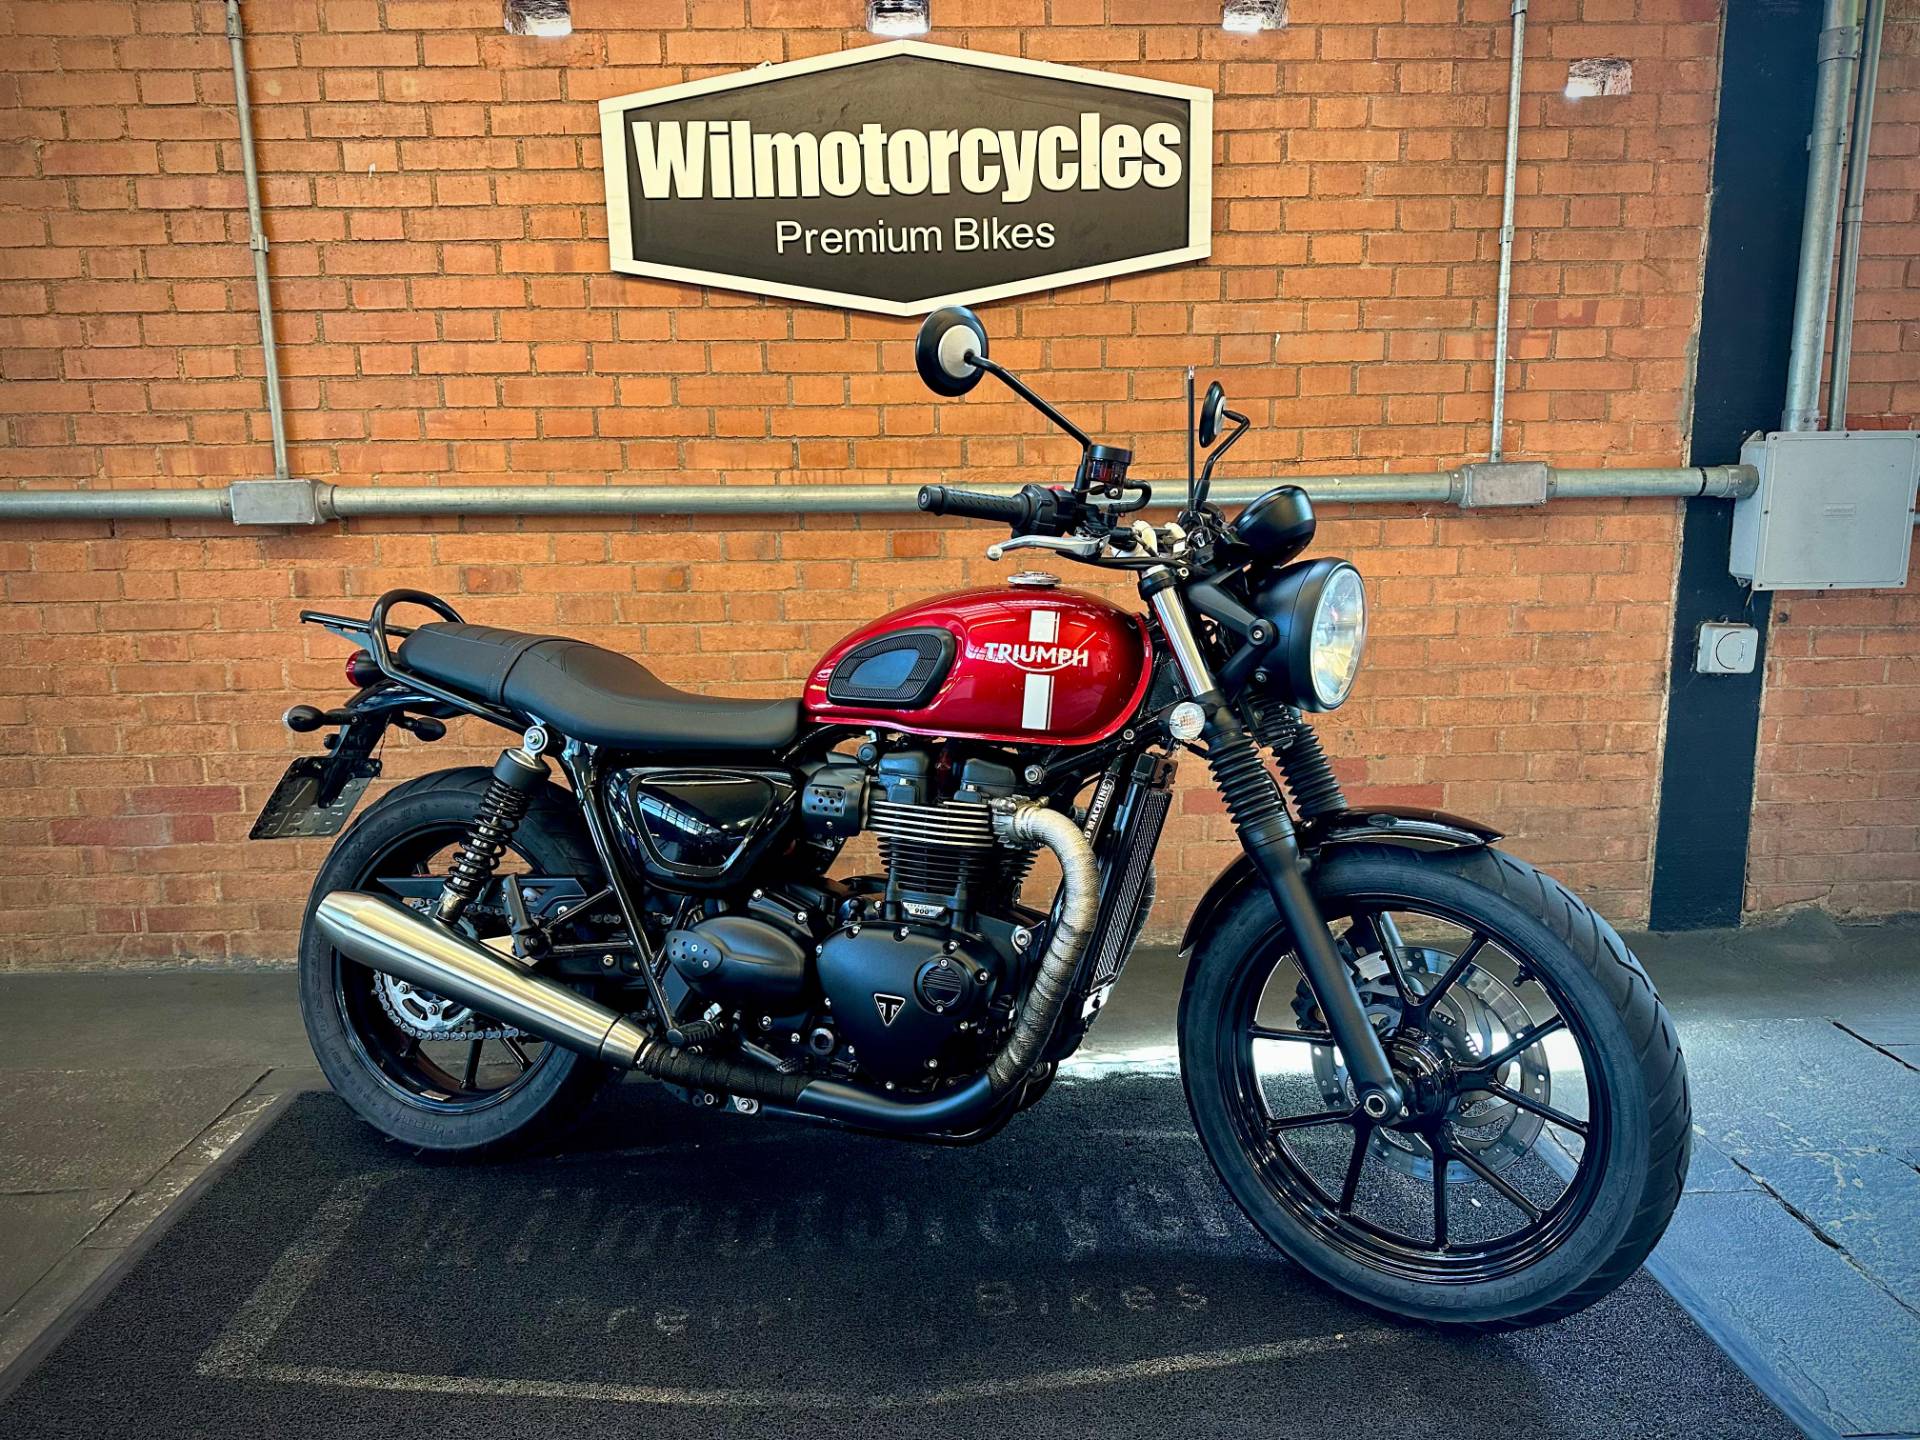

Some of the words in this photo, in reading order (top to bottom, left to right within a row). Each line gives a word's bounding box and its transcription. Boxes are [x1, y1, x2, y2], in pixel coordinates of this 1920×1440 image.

[632, 112, 1184, 203] Wilmotorcycles
[775, 219, 943, 254] Premium
[984, 641, 1090, 668] TRIUMPH
[1086, 781, 1111, 831] MACHINE
